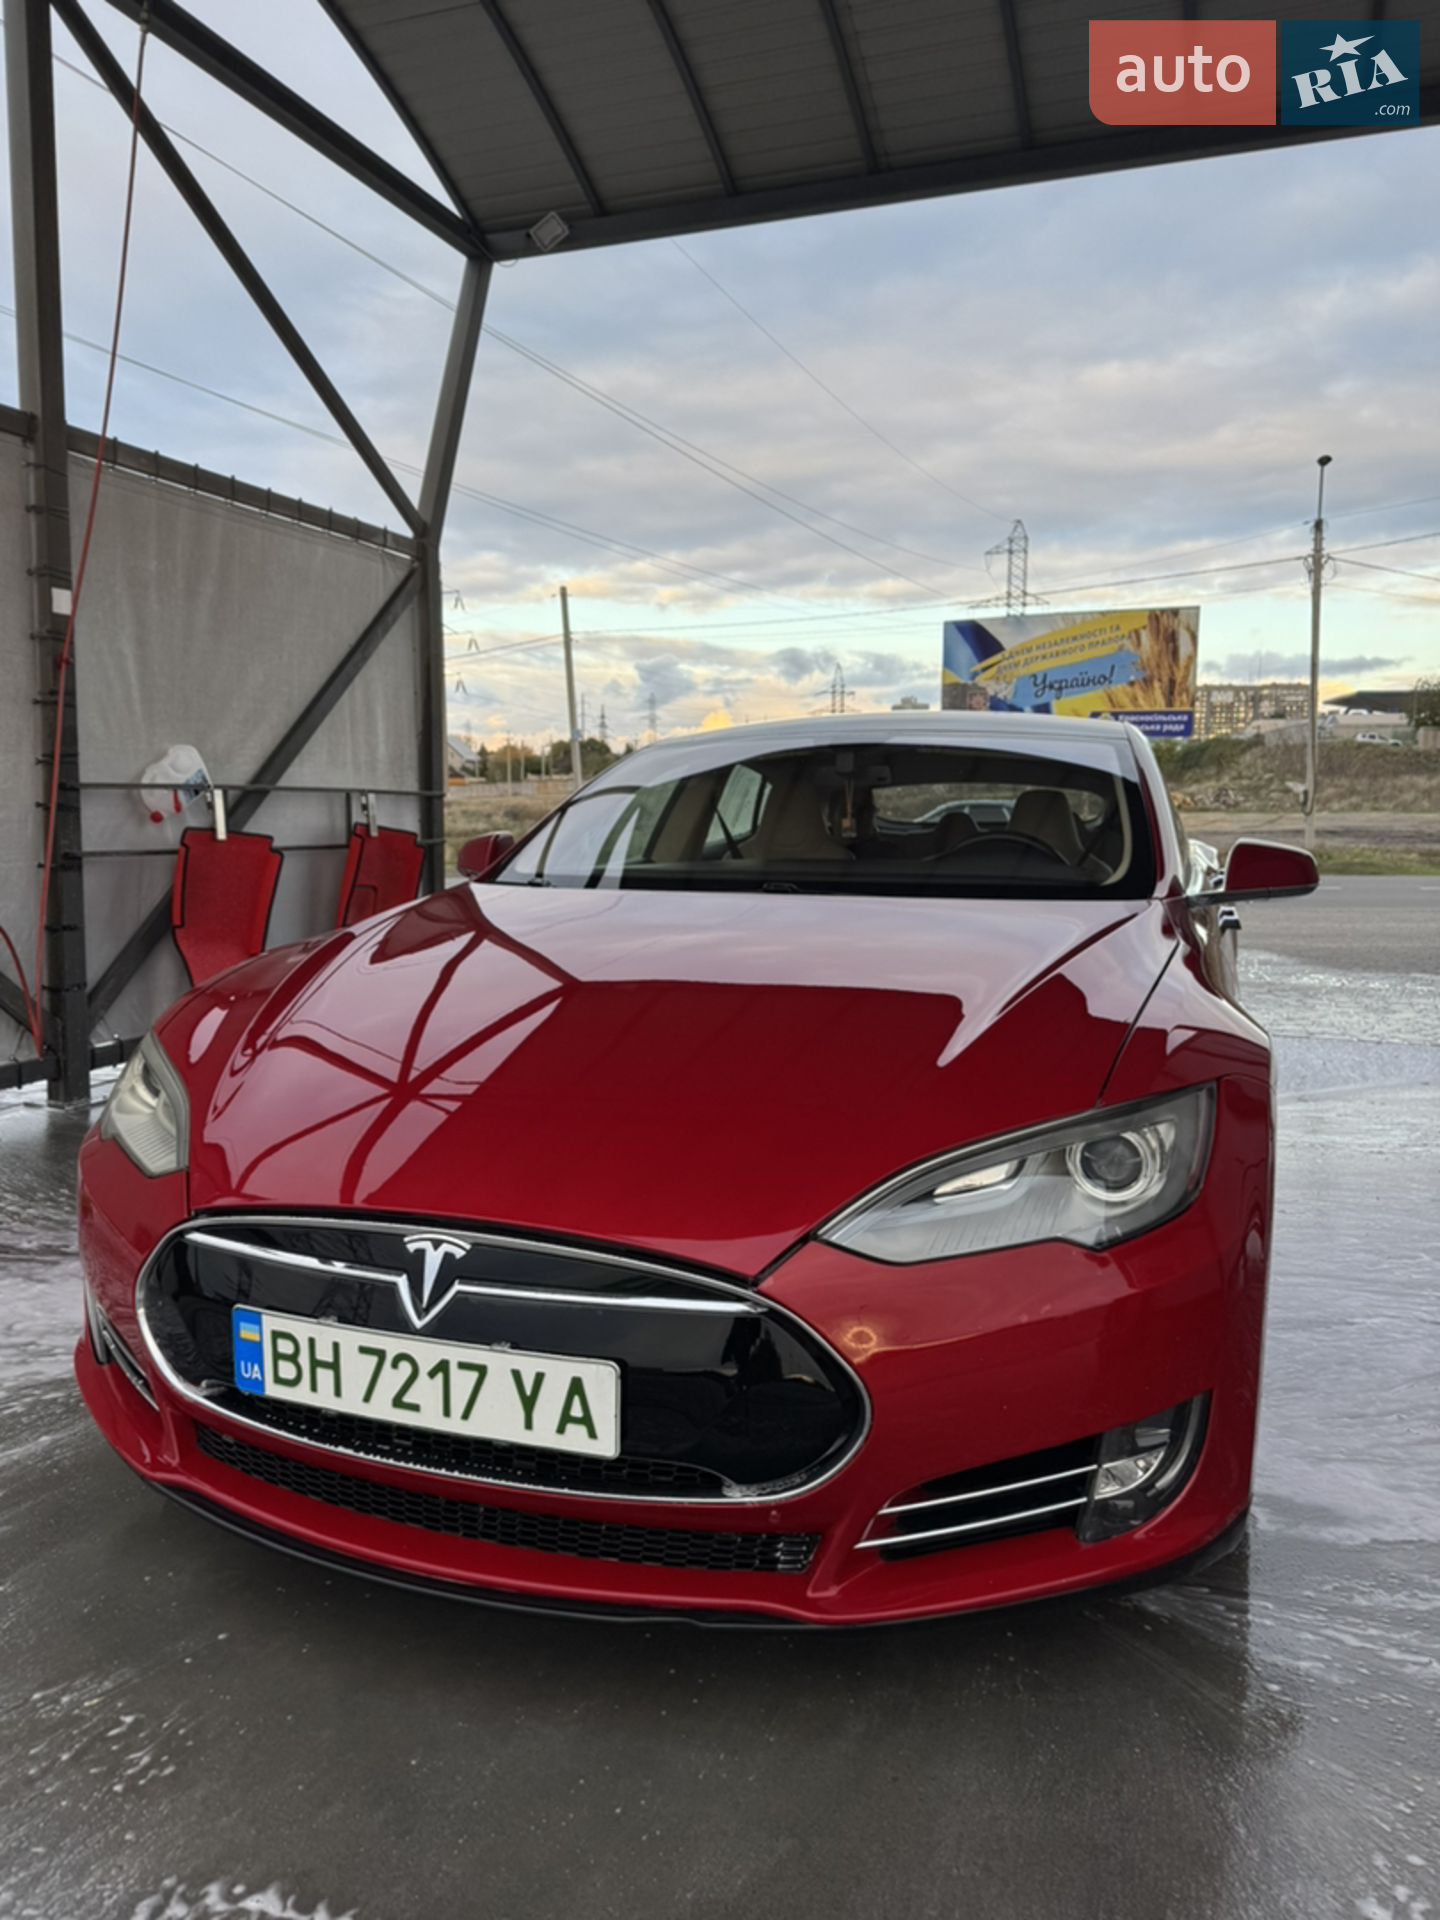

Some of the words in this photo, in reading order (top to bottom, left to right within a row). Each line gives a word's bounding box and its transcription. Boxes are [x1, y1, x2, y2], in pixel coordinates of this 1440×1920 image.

[1109, 624, 1121, 635] ТА
[1030, 664, 1115, 699] Україно!
[240, 1361, 263, 1382] UA
[269, 1328, 342, 1399] BH
[357, 1344, 488, 1422] 7217
[510, 1368, 599, 1441] YA
